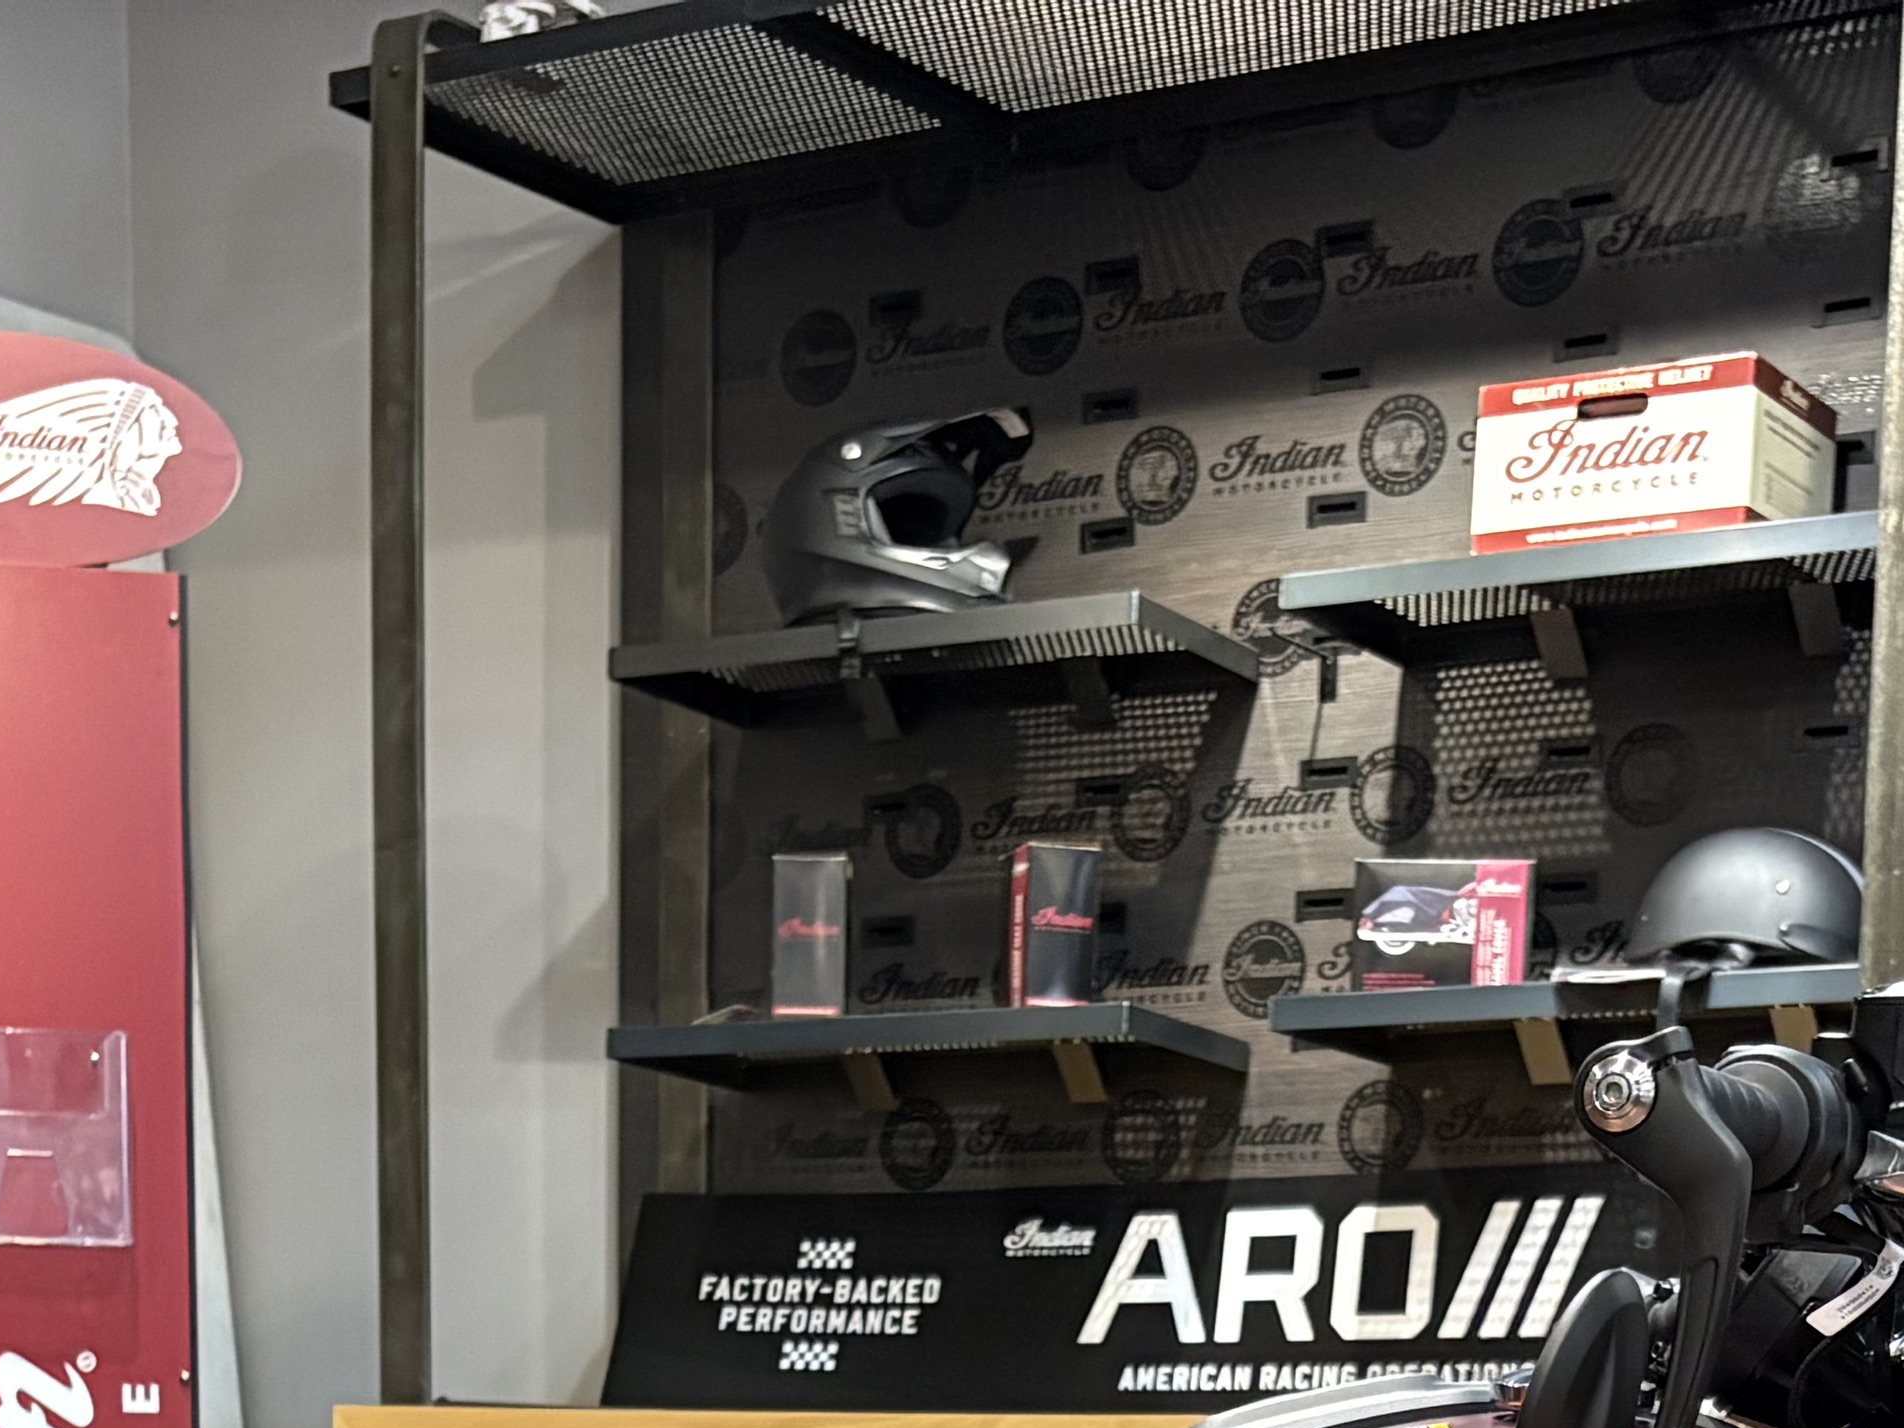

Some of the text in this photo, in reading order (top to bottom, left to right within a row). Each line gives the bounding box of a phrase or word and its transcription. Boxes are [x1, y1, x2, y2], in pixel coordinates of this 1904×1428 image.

[1209, 435, 1348, 484] Indian
[1505, 419, 1710, 484] Indian
[977, 465, 1104, 510] Indian
[1510, 472, 1700, 503] MOTORCYCLE
[1201, 777, 1338, 823] Indian
[1199, 1103, 1326, 1151] Indian
[1003, 1216, 1097, 1249] Indian
[698, 1273, 943, 1306] FACTORY-BACKED
[717, 1304, 922, 1336] PERFORMANCE
[1117, 1363, 1254, 1393] AMERICAN
[1259, 1363, 1357, 1392] RACING
